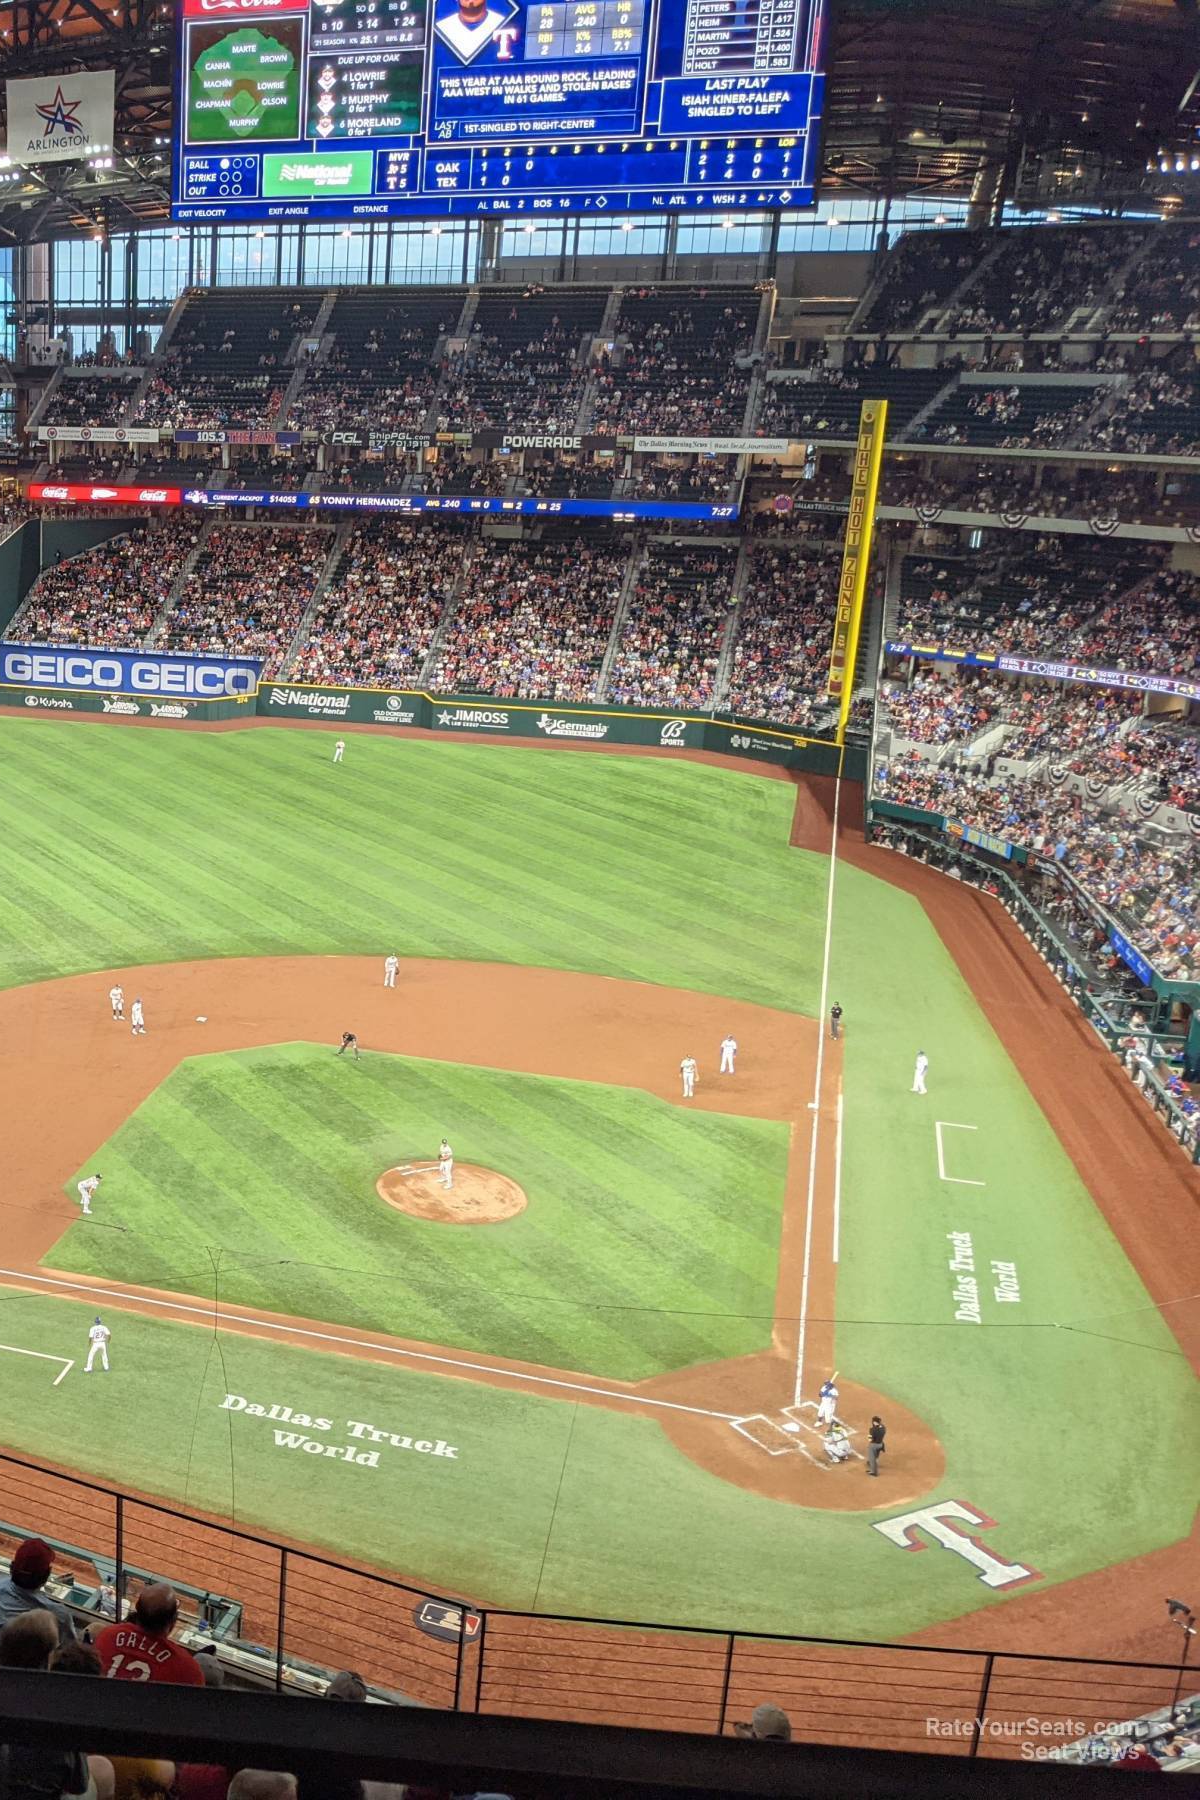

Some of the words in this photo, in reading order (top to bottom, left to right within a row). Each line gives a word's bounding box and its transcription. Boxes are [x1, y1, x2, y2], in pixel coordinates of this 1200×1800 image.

[700, 4, 730, 13] PETERS
[699, 18, 720, 27] HEIM
[697, 32, 730, 41] MARTIN
[232, 44, 257, 53] MARTE
[696, 47, 720, 55] POZO
[260, 55, 288, 63] BROWN
[338, 56, 354, 65] DUE
[355, 56, 365, 64] UP
[366, 55, 382, 63] FOR
[383, 54, 400, 62] OAK
[205, 62, 231, 71] CANHA
[695, 61, 717, 70] HOLT
[350, 71, 386, 82] LOWRIE
[440, 79, 460, 88] THIS
[462, 78, 486, 87] YEAR
[488, 77, 500, 86] AT
[502, 75, 523, 85] AAA
[524, 73, 559, 84] ROUND
[562, 72, 591, 82] ROCK,
[593, 70, 636, 80] LEADING
[257, 82, 285, 90] LOWRIE
[443, 88, 463, 97] AAA
[465, 87, 490, 96] WEST
[492, 87, 503, 95] IN
[505, 85, 537, 94] WALKS
[539, 84, 560, 93] AND
[562, 82, 599, 91] STOLEN
[601, 80, 631, 89] BASES
[705, 79, 735, 90] LAST
[737, 77, 769, 89] PLAY
[261, 97, 287, 106] OLSON
[349, 94, 389, 104] MURPHY
[504, 96, 514, 105] IN
[516, 95, 527, 103] 61
[682, 95, 710, 106] ISIAH
[712, 92, 790, 104] KINER-FALEFA
[195, 100, 231, 109] CHAPMAN
[688, 106, 735, 117] SINGLED
[737, 105, 755, 115] TO
[757, 104, 781, 114] LEFT
[229, 118, 259, 127] MURPHY
[347, 117, 401, 128] MORELAND
[434, 121, 457, 130] LAST
[464, 123, 517, 133] 1ST-SINGLED
[518, 122, 531, 131] TO
[532, 119, 595, 130] RIGHT-CENTER
[438, 130, 452, 138] AB
[27, 136, 90, 152] ARLINGTON
[189, 160, 209, 170] BALL
[436, 163, 460, 173] OAK
[188, 174, 216, 182] STRIKE
[437, 178, 457, 187] TEX
[188, 187, 207, 196] OUT
[493, 200, 510, 209] BAL
[533, 200, 552, 208] BOS
[669, 196, 686, 205] ATL
[713, 195, 735, 203] WSH
[178, 210, 192, 218] EXIT
[194, 209, 226, 217] VELOCITY
[285, 207, 309, 215] ANGLE
[353, 205, 389, 213] DISTANCE
[197, 432, 225, 442] 105.3
[331, 432, 364, 444] PGL
[502, 435, 582, 449] POWERADE
[855, 435, 871, 484] THE
[269, 495, 297, 504] $14055
[309, 496, 321, 505] 65
[322, 496, 354, 505] YONNY
[355, 497, 411, 507] HERNANDEZ
[442, 500, 461, 508] .240
[712, 507, 733, 516] 7:27
[850, 496, 864, 546] HOT
[840, 558, 856, 623] ZONE
[890, 643, 906, 652] 7:27
[4, 653, 123, 688] GEICO
[130, 662, 257, 695] GEICO
[39, 697, 74, 709] Kubota
[288, 691, 350, 708] National
[555, 718, 607, 734] Germania
[660, 738, 684, 746] SPORTS
[949, 1231, 975, 1273] Truck
[991, 1261, 1021, 1303] World
[955, 1276, 982, 1324] Dallas
[218, 1394, 333, 1430] Dallas
[346, 1421, 459, 1459] Truck
[273, 1430, 381, 1468] World
[116, 1632, 172, 1663] GALLO
